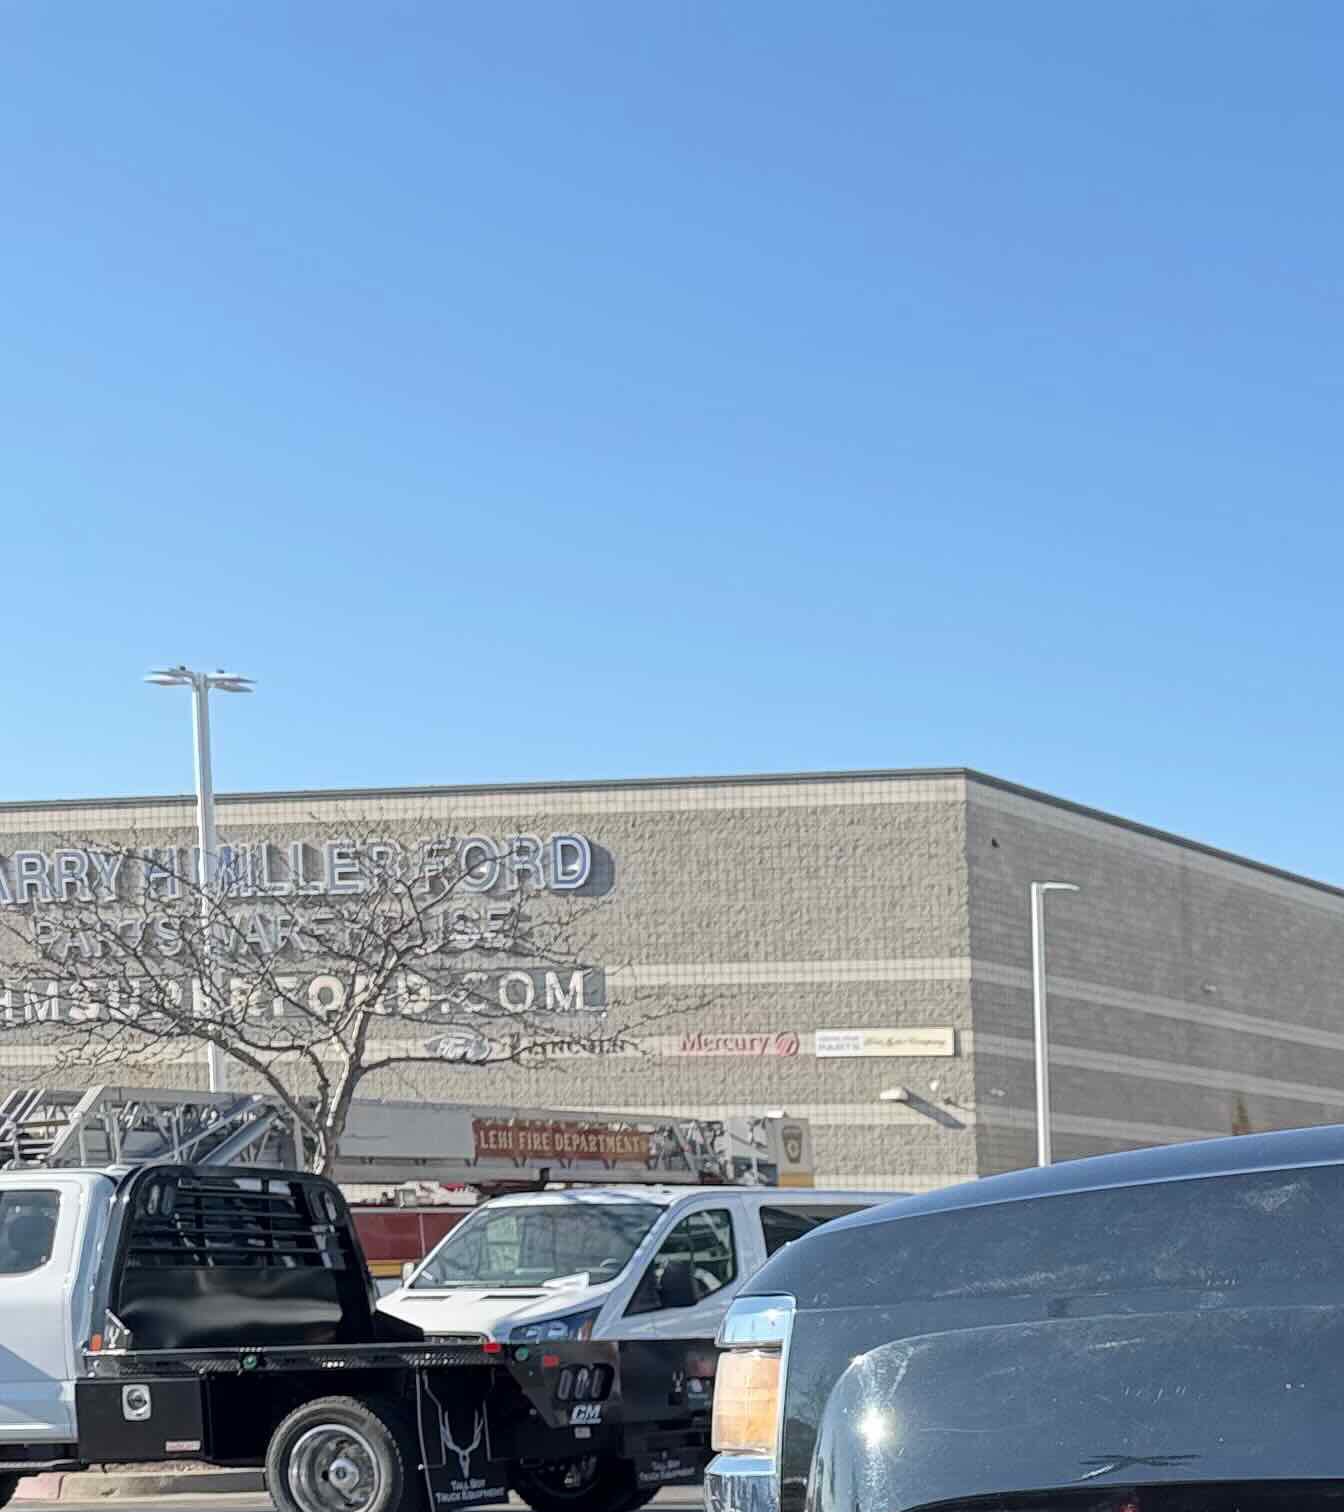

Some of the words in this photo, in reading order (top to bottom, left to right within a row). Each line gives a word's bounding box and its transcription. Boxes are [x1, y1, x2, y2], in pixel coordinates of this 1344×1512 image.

[143, 846, 180, 900] H
[416, 833, 592, 893] FORD
[682, 1033, 770, 1056] Mercury
[480, 1130, 513, 1149] LEHI
[519, 1131, 551, 1151] FIRE
[555, 1133, 641, 1153] DEPARTMENT
